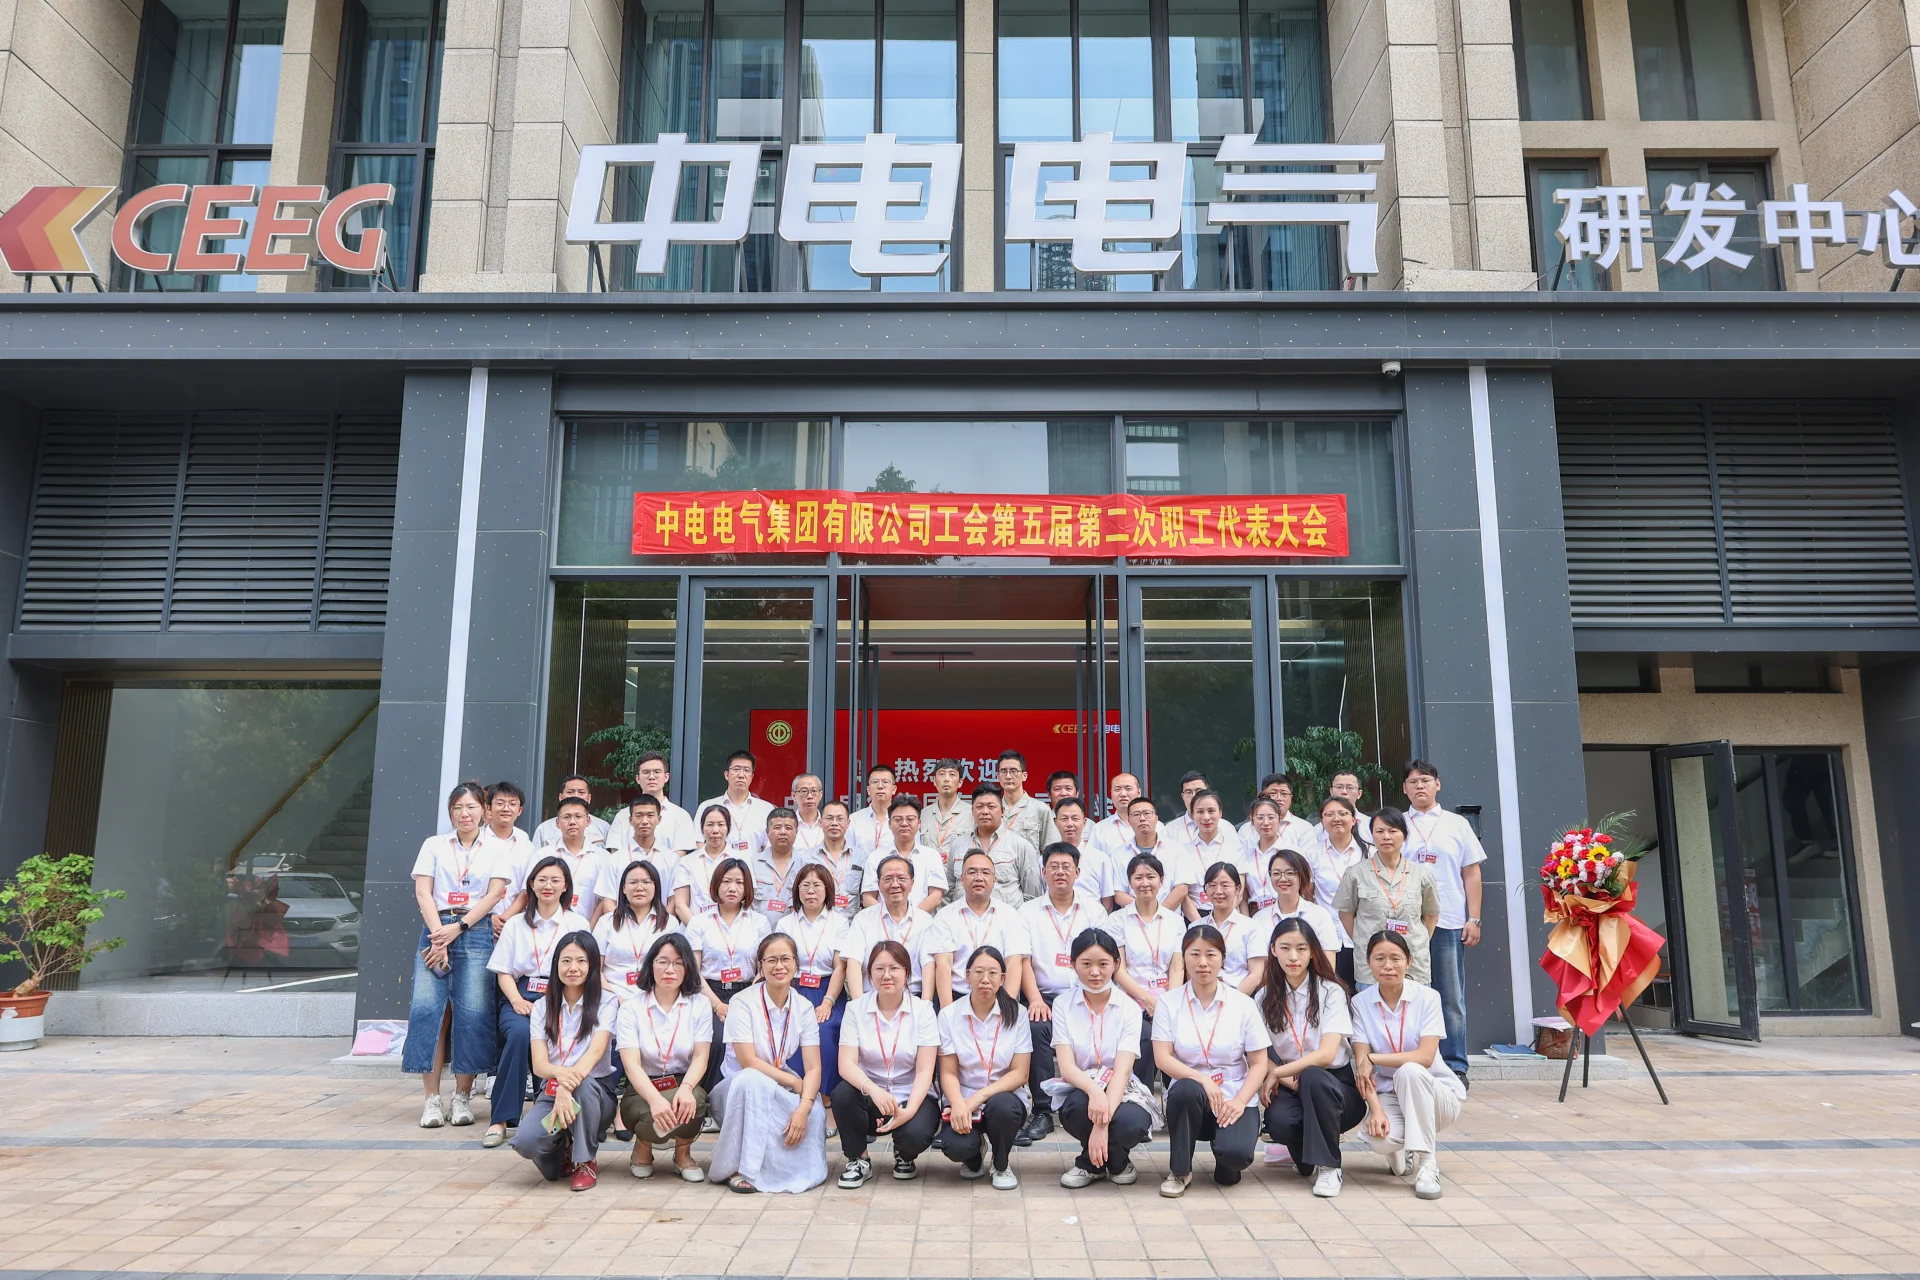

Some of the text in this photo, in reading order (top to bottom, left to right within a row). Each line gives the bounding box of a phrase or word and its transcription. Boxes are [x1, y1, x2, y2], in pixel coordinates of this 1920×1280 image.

[111, 183, 396, 275] CEEG
[565, 132, 1386, 277] 中电电气
[1554, 182, 1920, 273] 研发中心
[655, 498, 1328, 549] 中电电气集团有限公司工会第五届第二次职工代表大会
